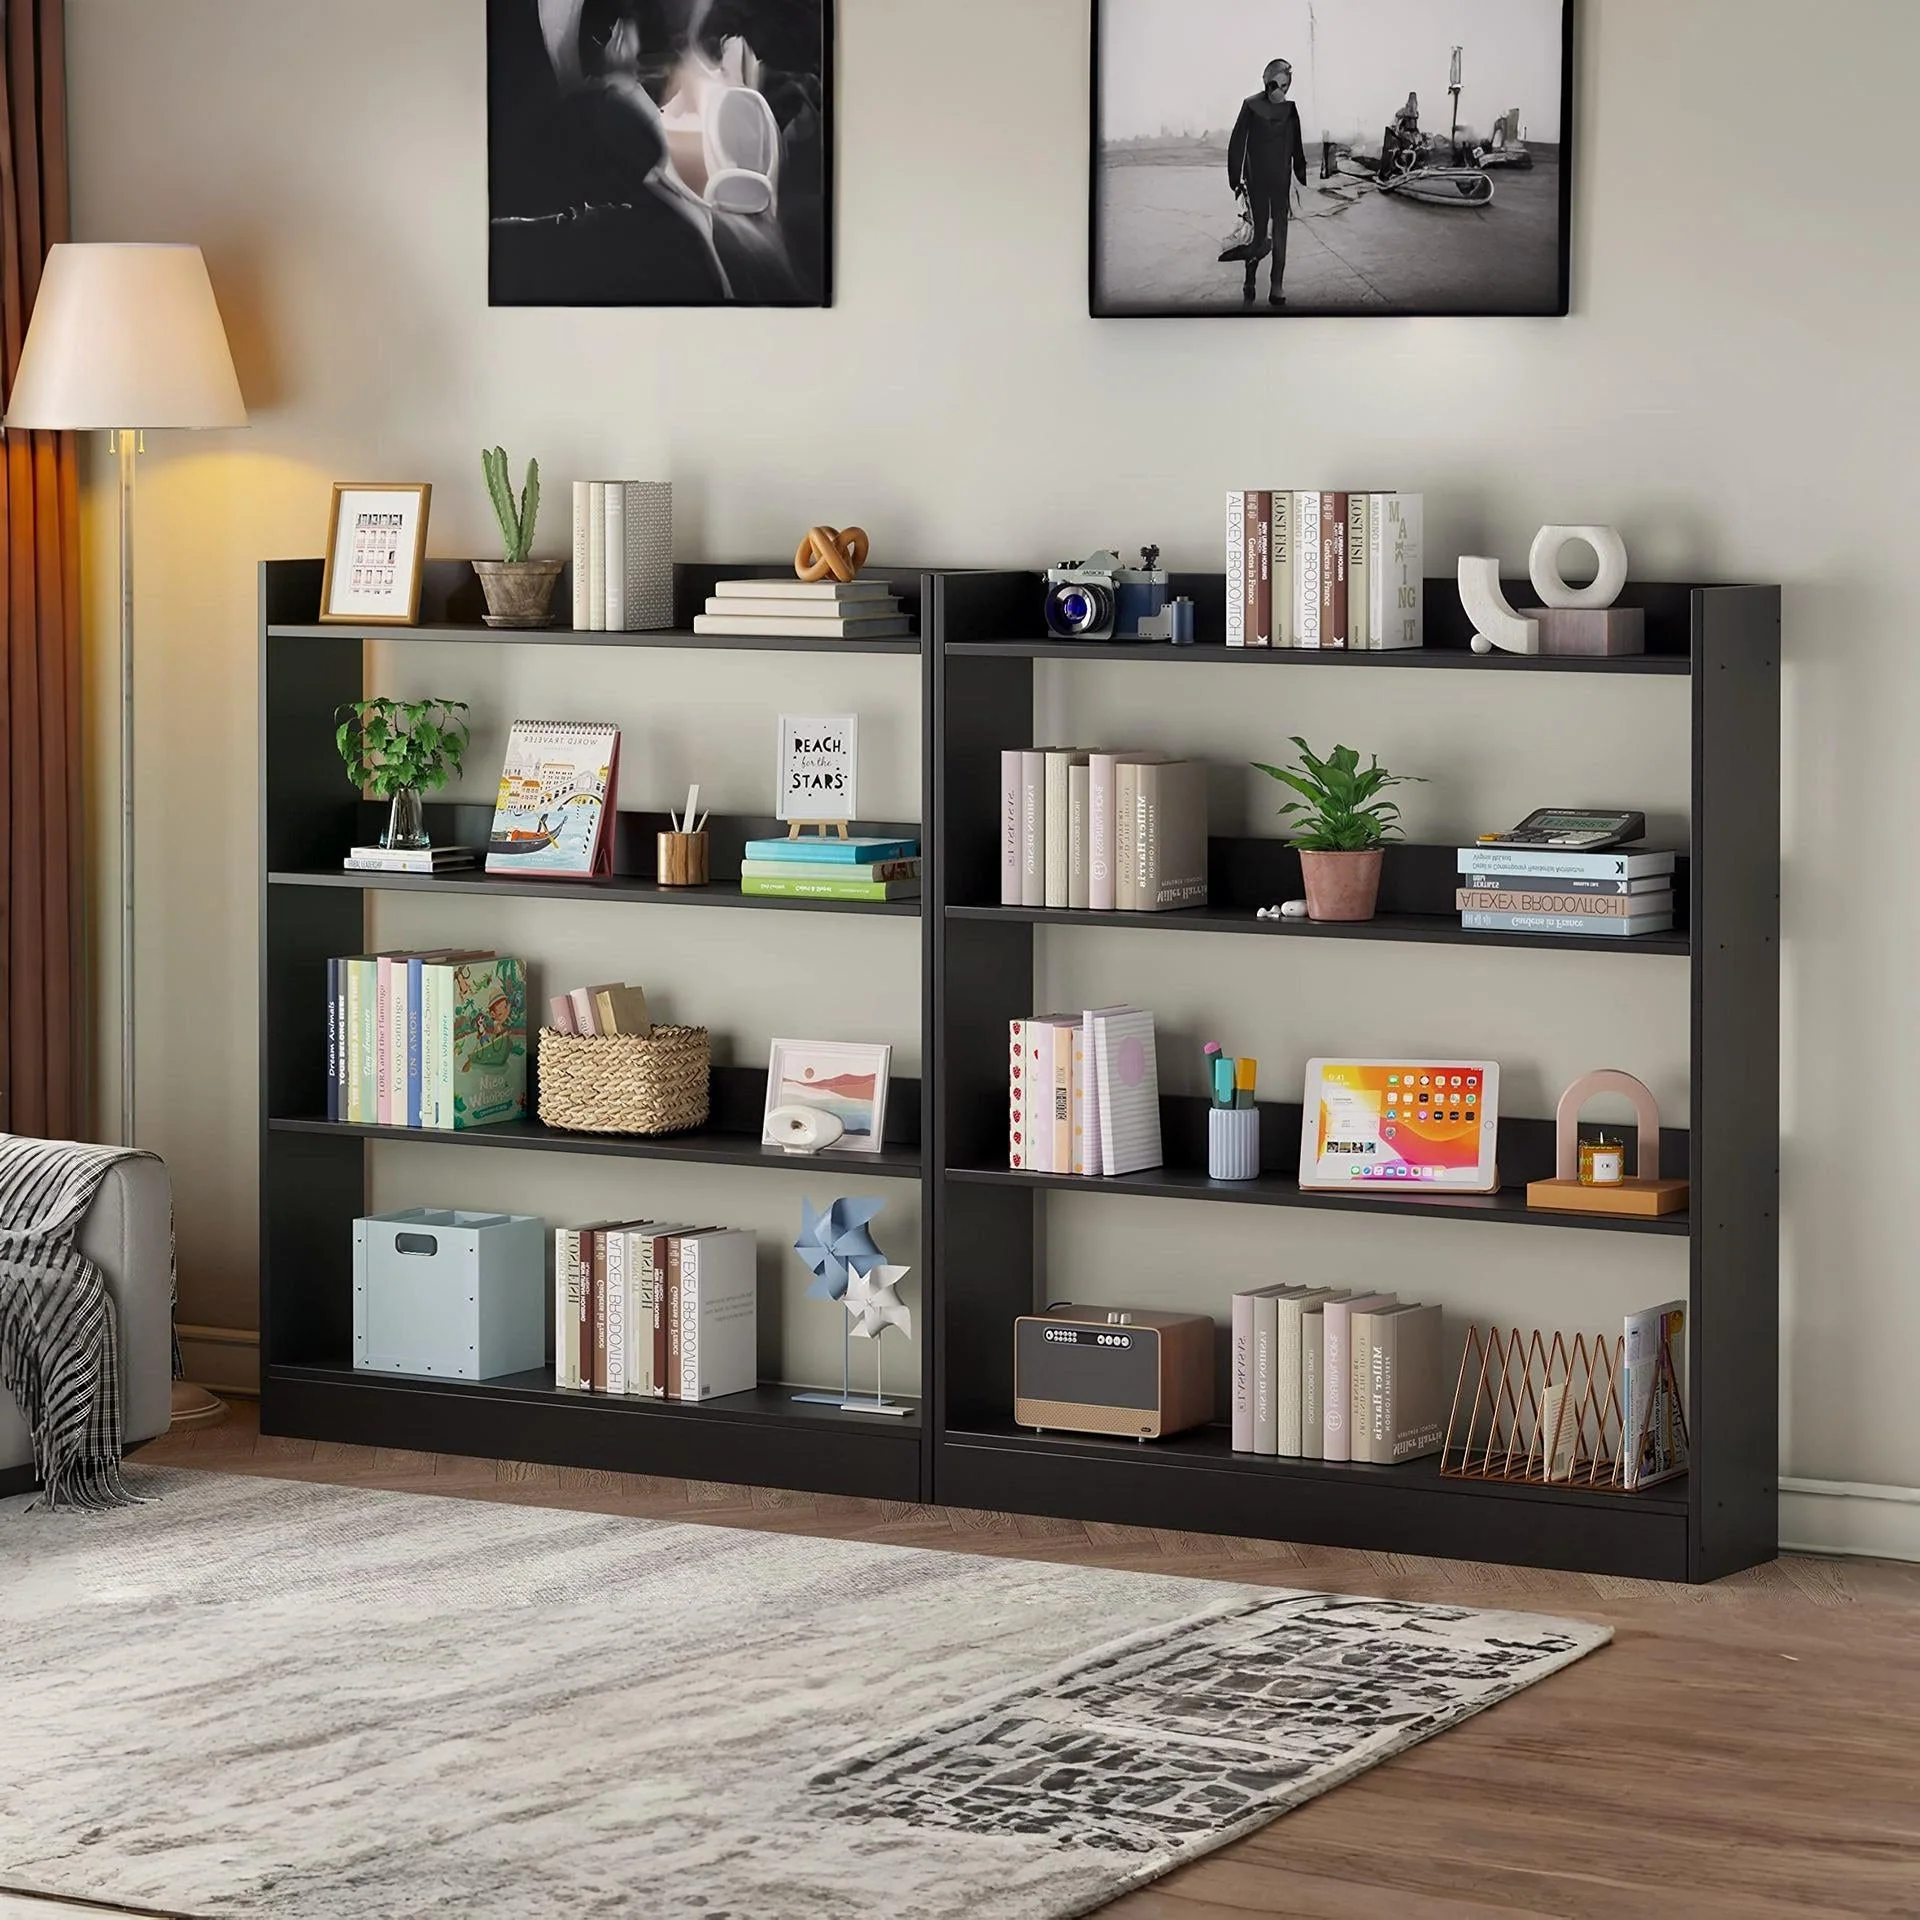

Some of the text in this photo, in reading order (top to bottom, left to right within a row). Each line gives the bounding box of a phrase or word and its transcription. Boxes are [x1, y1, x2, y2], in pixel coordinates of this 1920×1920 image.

[1275, 497, 1286, 563] LOST FISH
[1351, 499, 1362, 565] LOST FISH
[1324, 539, 1332, 569] Gardens
[1373, 542, 1379, 552] IT
[1229, 496, 1241, 635] ALEXEY BRODOVITCH
[1304, 496, 1317, 637] ALEXEY BRODOVITCH
[1324, 581, 1332, 606] France
[794, 737, 841, 753] REACH
[801, 756, 832, 768] for the
[792, 773, 843, 789] STARS
[395, 997, 403, 1048] conmigo
[424, 1023, 430, 1036] de
[410, 1058, 417, 1077] UN
[1328, 1073, 1345, 1081] 9:41
[394, 1077, 402, 1092] Yo
[424, 1094, 432, 1115] Los
